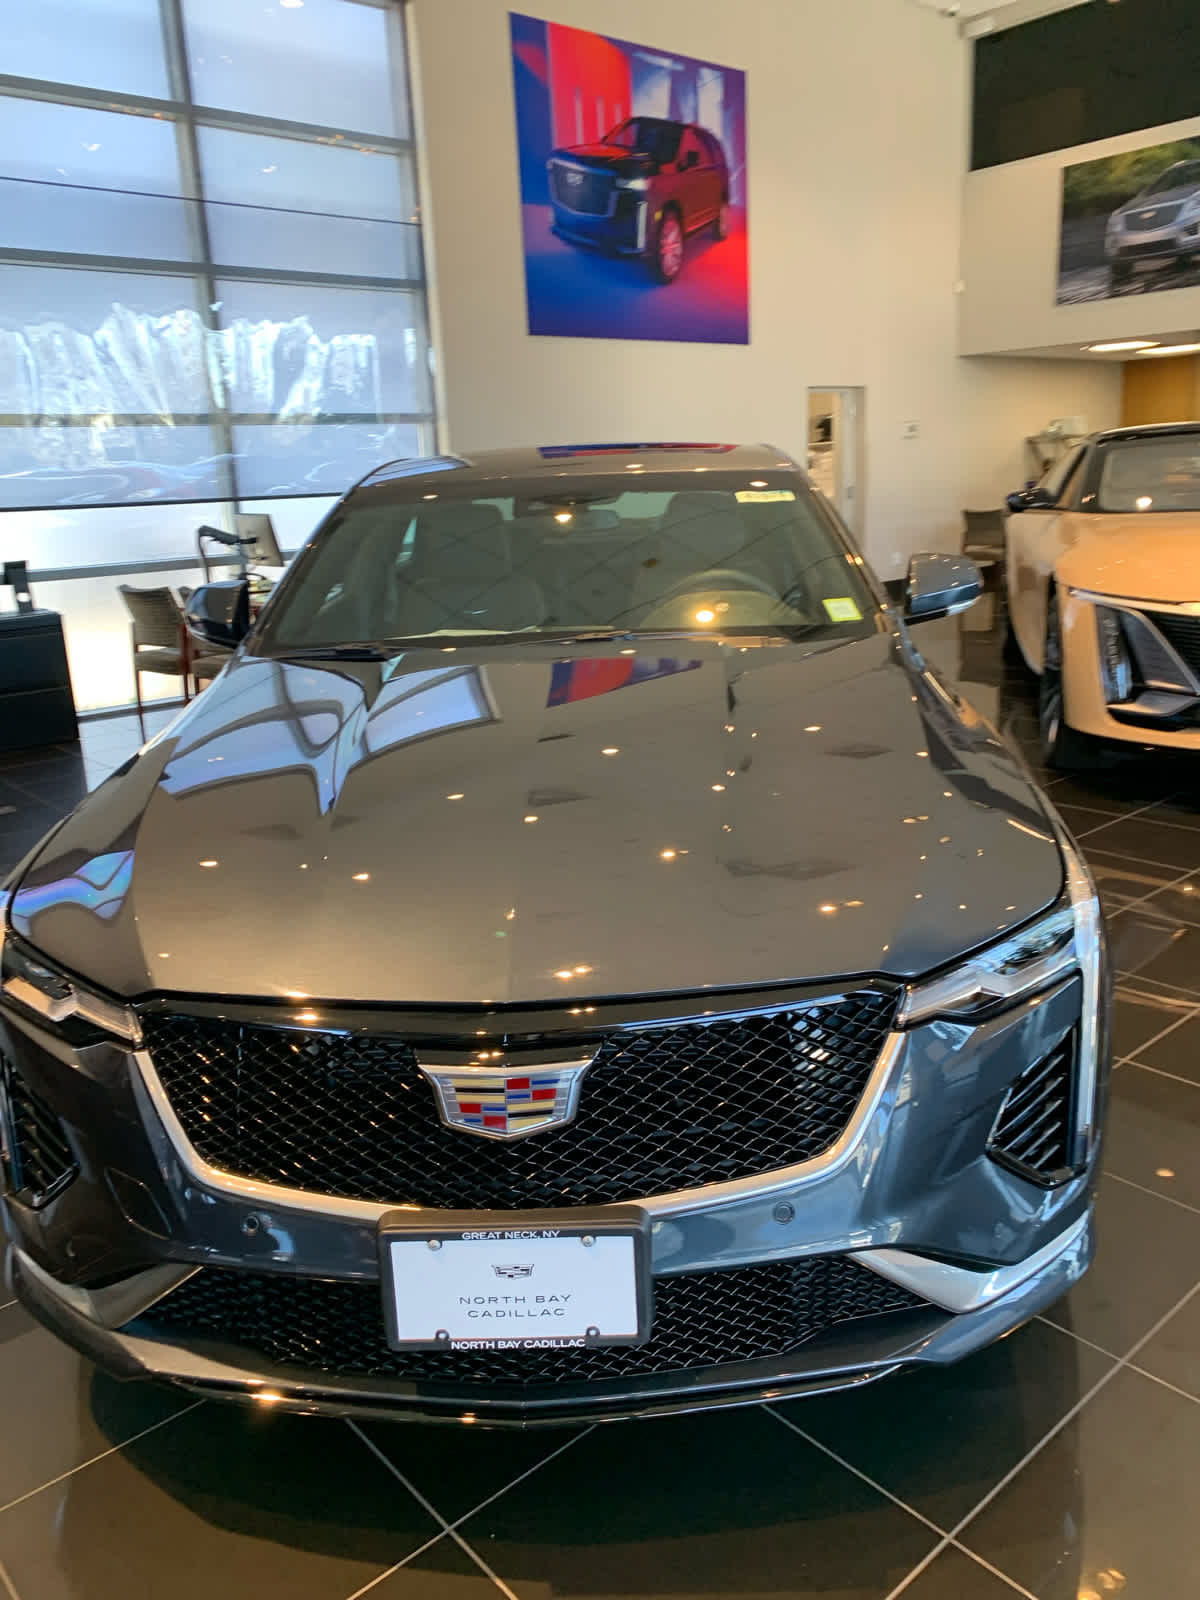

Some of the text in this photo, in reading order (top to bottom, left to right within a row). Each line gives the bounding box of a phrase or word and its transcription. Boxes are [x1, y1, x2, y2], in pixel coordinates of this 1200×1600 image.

[461, 1231, 501, 1240] GREAT
[542, 1230, 560, 1239] NY
[459, 1294, 572, 1305] NORTH BAY
[467, 1308, 566, 1318] CADILLAC
[450, 1338, 586, 1350] NORTH BAY CADILLAC
